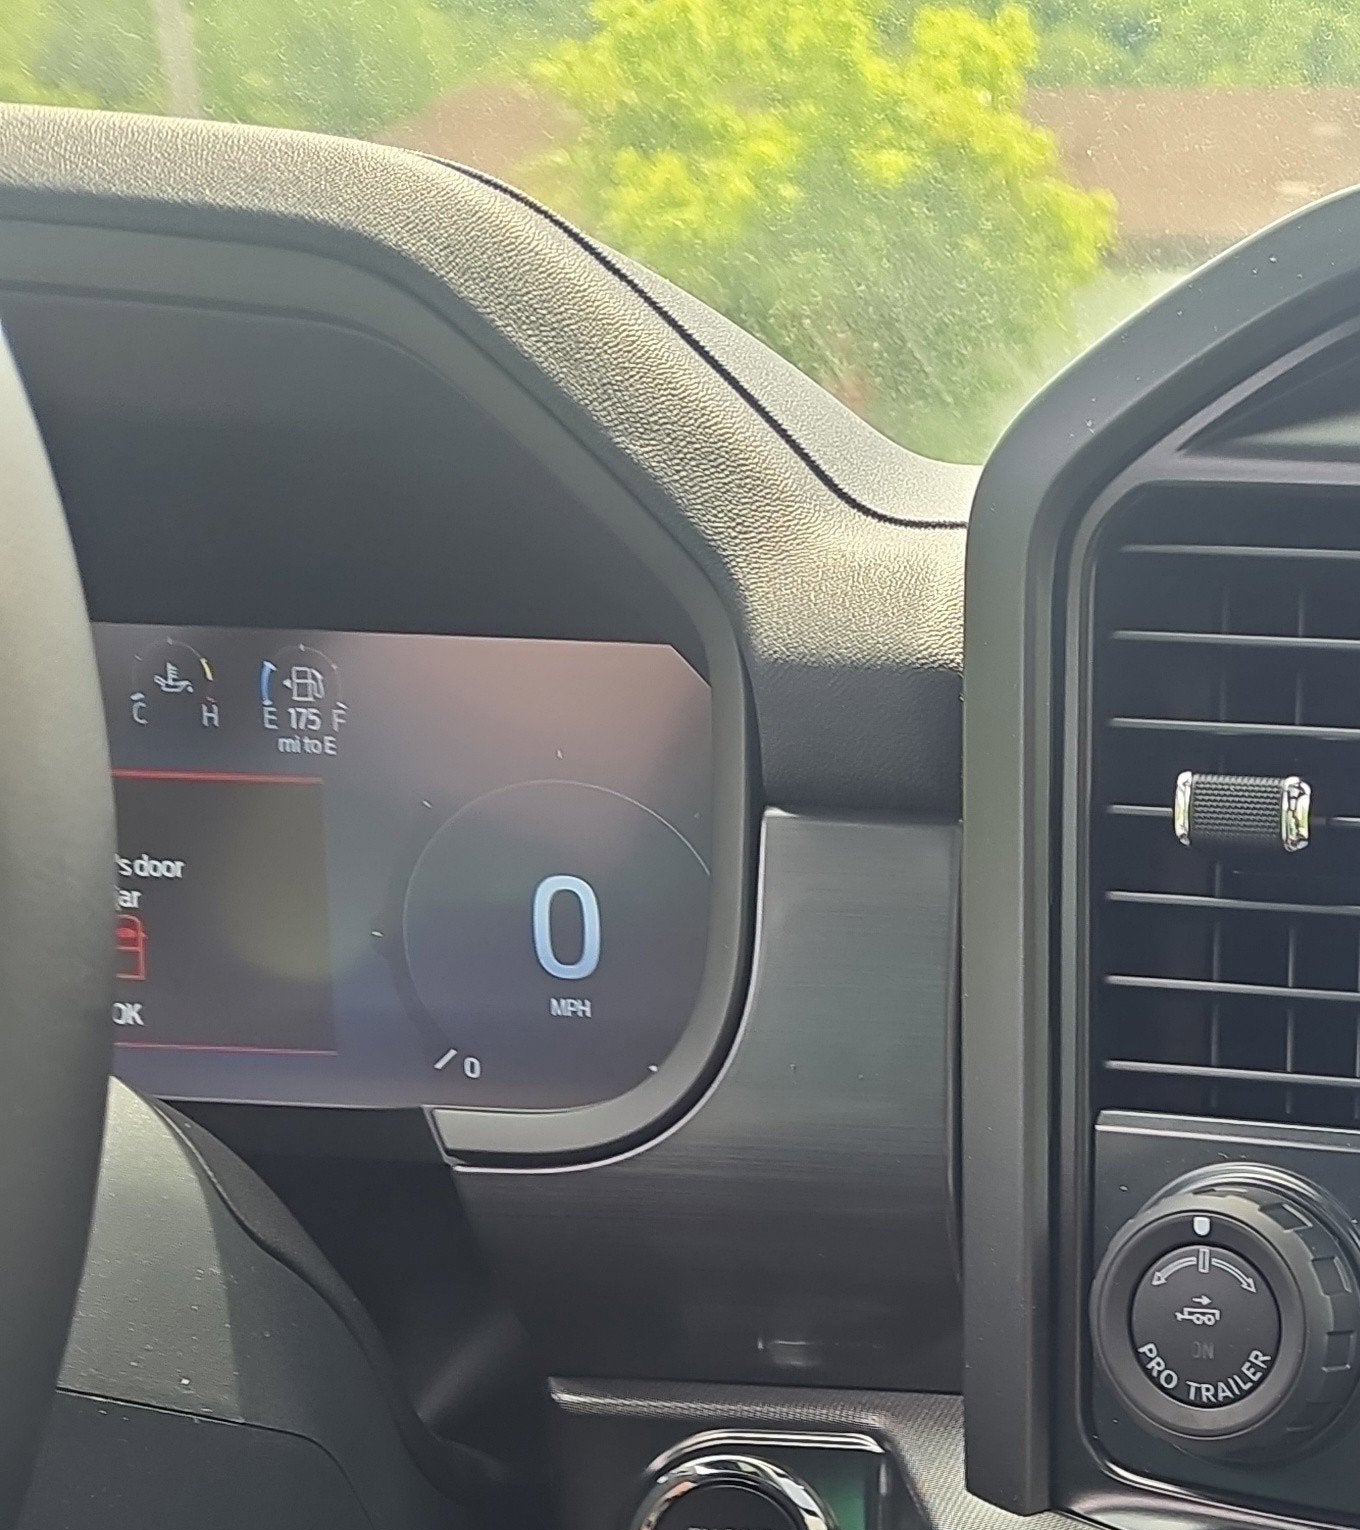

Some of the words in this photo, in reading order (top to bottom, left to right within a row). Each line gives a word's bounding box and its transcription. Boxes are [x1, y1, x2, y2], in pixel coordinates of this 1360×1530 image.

[201, 703, 219, 727] H
[263, 706, 279, 730] E
[288, 707, 321, 730] 175
[332, 708, 348, 732] F
[133, 855, 186, 879] door
[532, 874, 601, 981] 0
[550, 998, 591, 1020] MPH
[464, 1058, 481, 1080] 0
[1137, 1342, 1178, 1390] PRO
[1185, 1349, 1272, 1403] TRAILER
